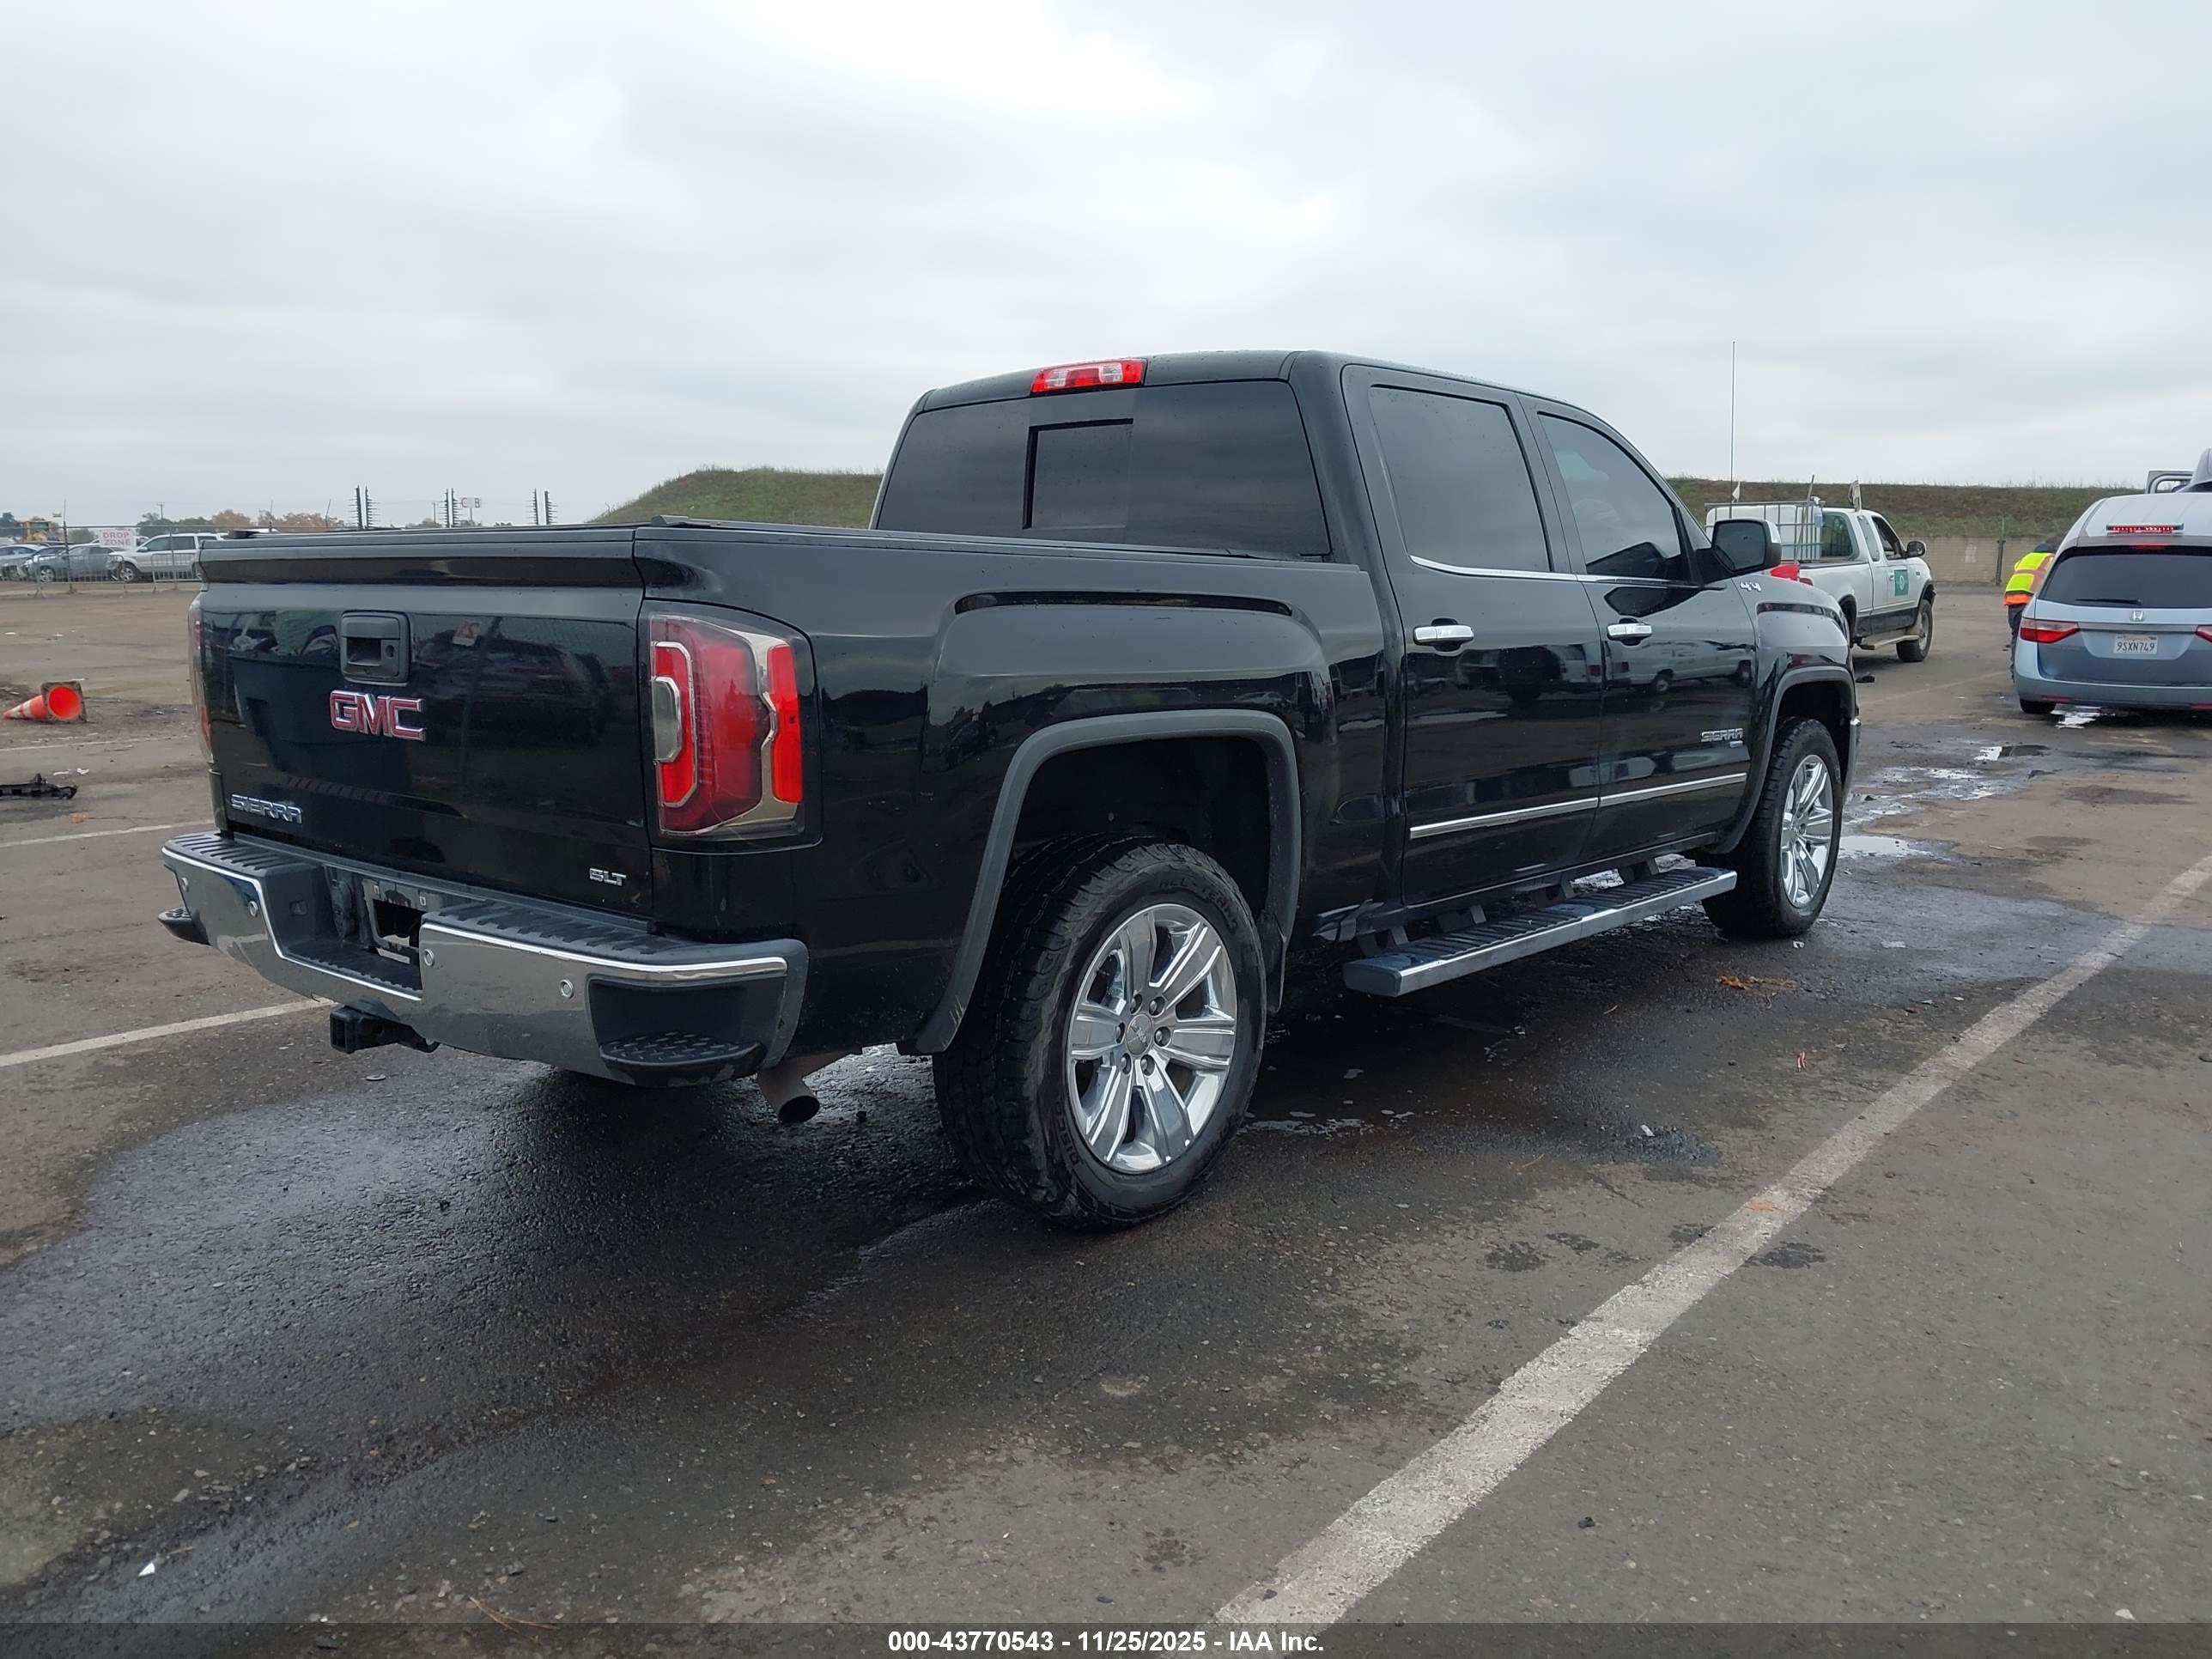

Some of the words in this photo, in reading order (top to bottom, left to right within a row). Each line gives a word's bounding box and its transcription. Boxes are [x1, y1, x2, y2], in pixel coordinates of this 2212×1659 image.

[2117, 641, 2155, 652] 9SXN749
[330, 690, 427, 742] GMC
[1700, 727, 1744, 743] SIERRA
[231, 793, 302, 824] SIERRA
[589, 867, 628, 887] SLT
